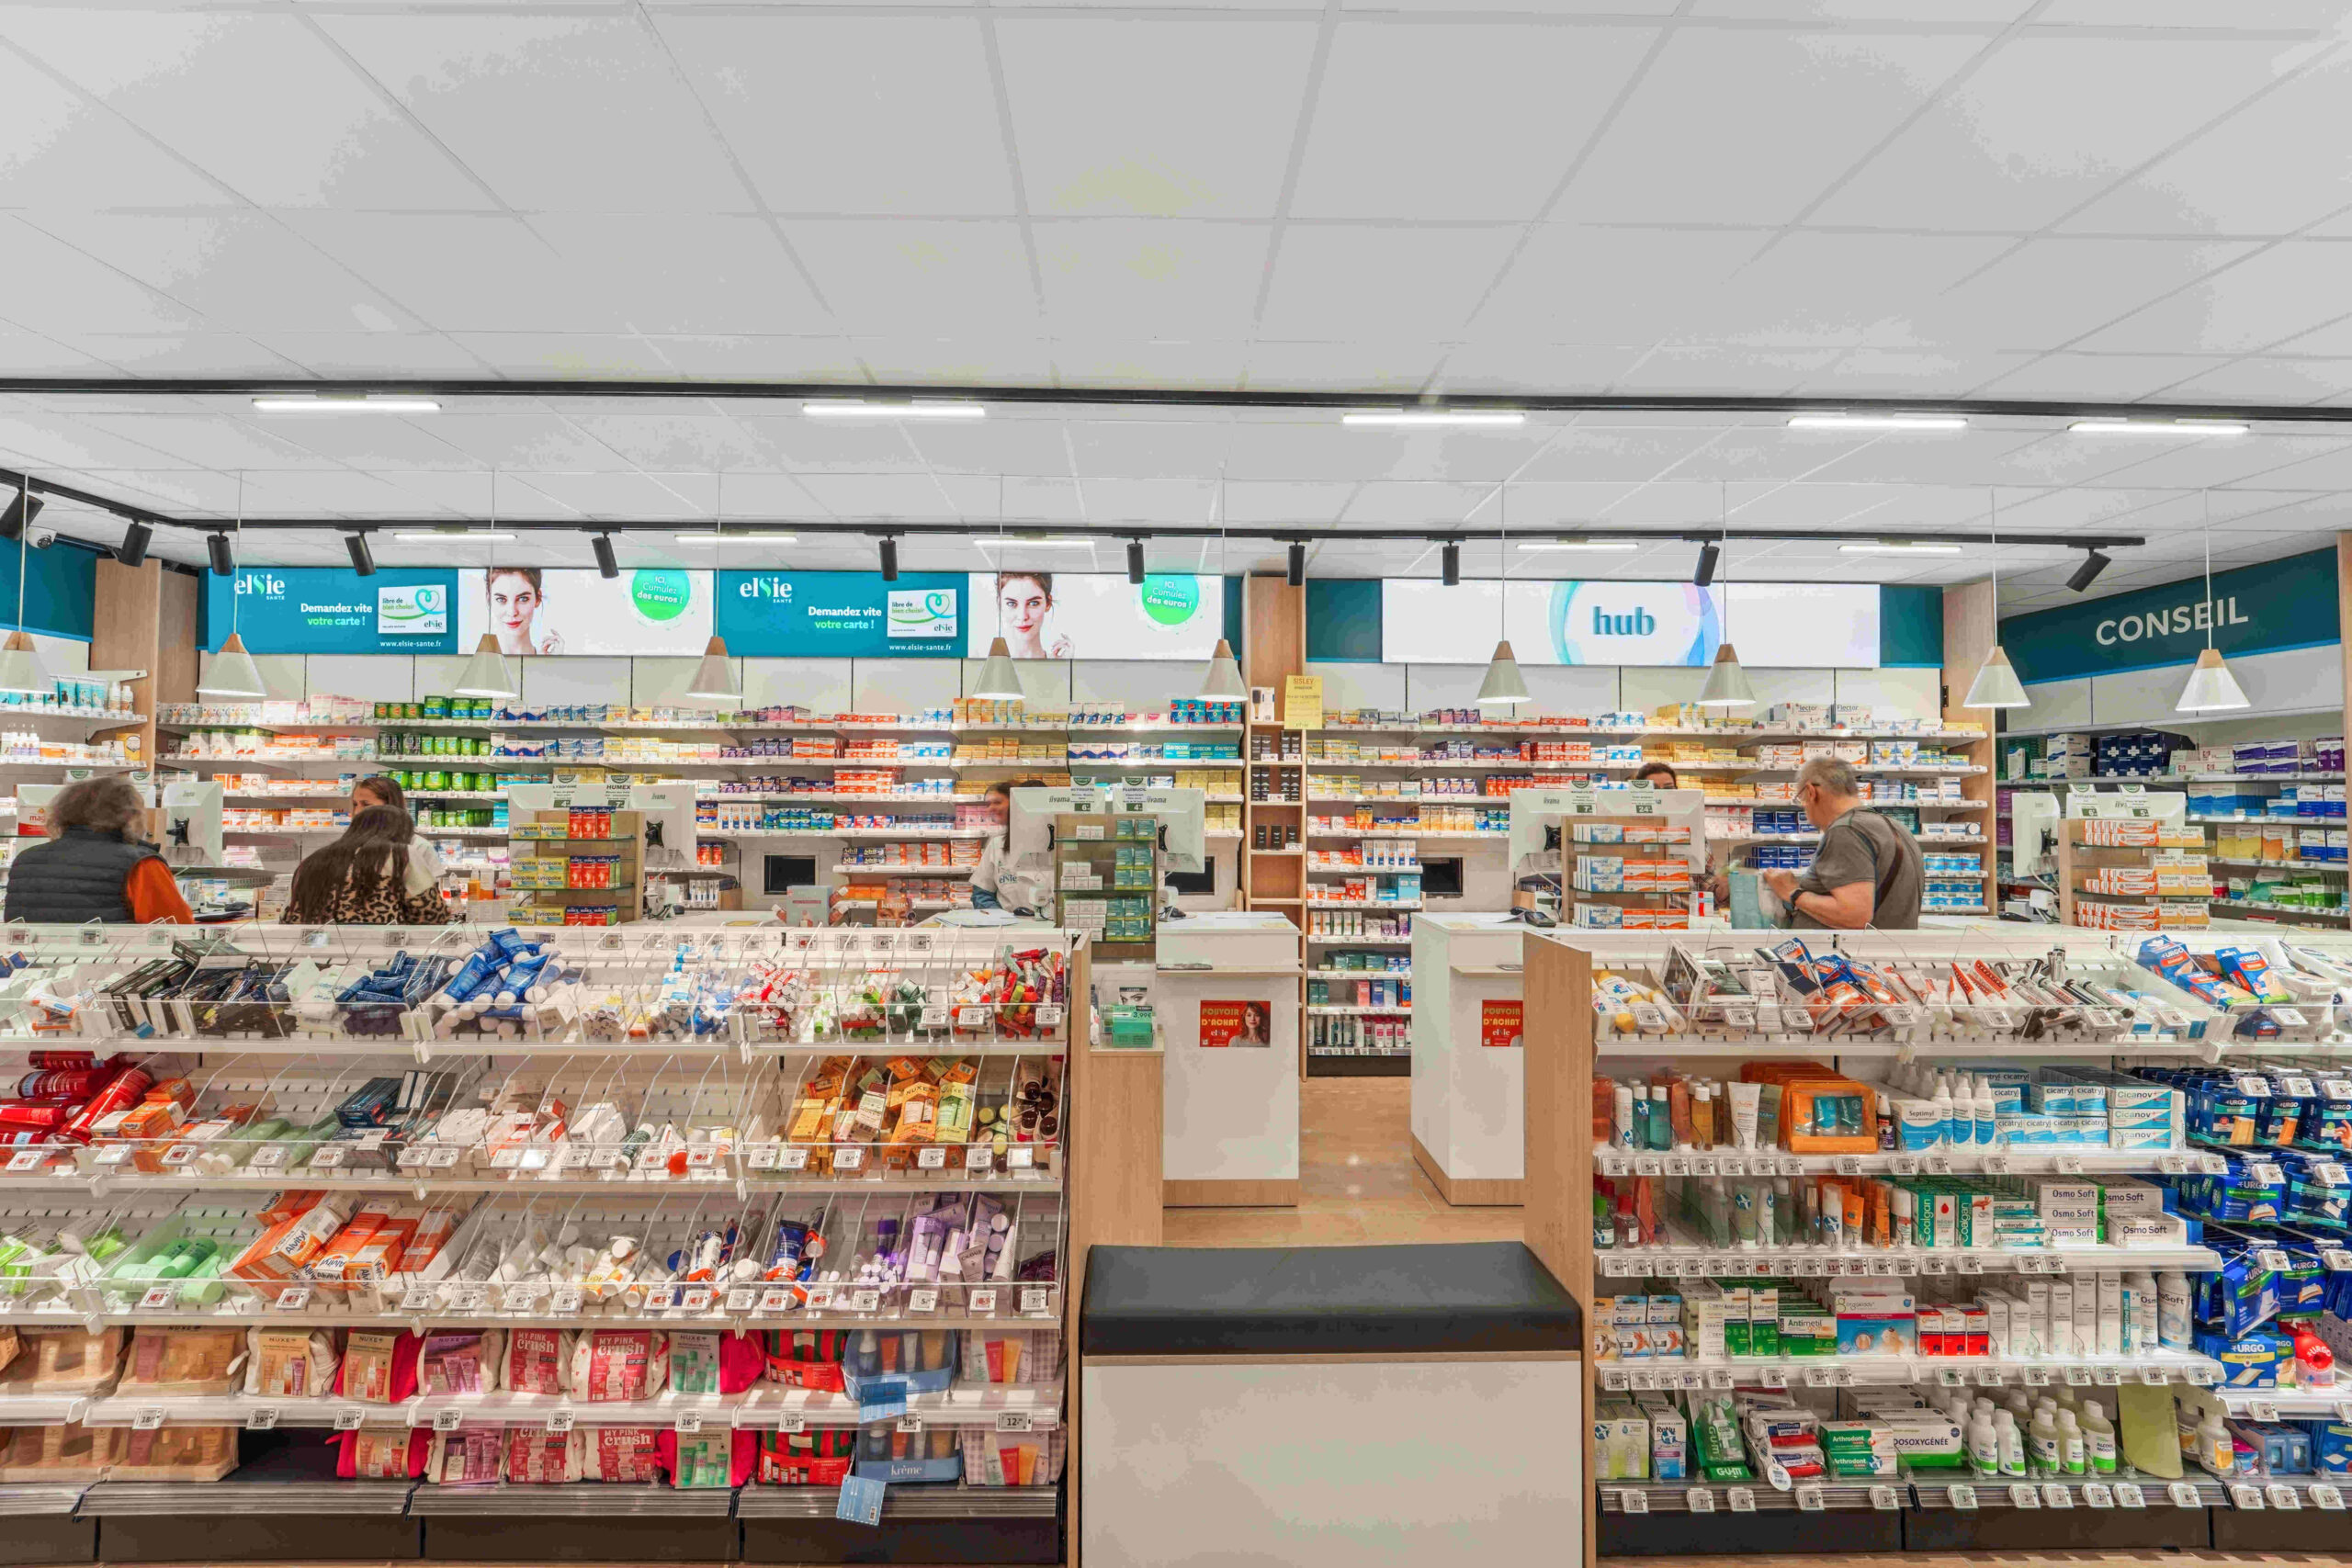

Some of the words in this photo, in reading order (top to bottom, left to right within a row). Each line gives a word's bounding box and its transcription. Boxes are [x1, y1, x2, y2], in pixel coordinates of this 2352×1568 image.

[642, 582, 677, 594] Cumulez
[740, 577, 792, 597] elsie
[637, 590, 652, 600] des
[653, 592, 677, 604] euros
[1152, 587, 1186, 600] Cumulez
[1147, 595, 1161, 605] des
[1162, 598, 1186, 608] euros
[300, 604, 352, 613] Demandez
[354, 604, 372, 613] vite
[808, 605, 860, 616] Demandez
[863, 606, 882, 615] vite
[308, 617, 333, 626] votre
[335, 616, 359, 626] carte
[815, 620, 841, 629] votre
[843, 620, 868, 629] carte
[1592, 605, 1657, 636] hub
[2095, 596, 2247, 646] CONSEIL
[2165, 946, 2184, 958] URGO
[2243, 954, 2260, 963] URGO
[1202, 1008, 1239, 1016] POUVOIR
[2003, 1073, 2029, 1081] cicatryl
[906, 1085, 928, 1096] NUXE
[1994, 1089, 2019, 1098] cicatryl
[2046, 1087, 2074, 1096] cicatryl
[2076, 1087, 2104, 1096] cicatryl
[1908, 1110, 1934, 1118] Septimyl
[1997, 1119, 2022, 1128] cicatryl
[2026, 1119, 2051, 1128] cicatryl
[2053, 1119, 2079, 1128] cicatryl
[2081, 1118, 2107, 1127] cicatryl
[2243, 1181, 2269, 1190] URGO
[2052, 1190, 2075, 1198] Osmo
[2077, 1189, 2095, 1198] Soft
[2104, 1193, 2124, 1201] Osmo
[2126, 1193, 2144, 1201] Soft
[2052, 1209, 2075, 1217] Osmo
[2077, 1208, 2094, 1217] Soft
[1920, 1199, 1934, 1242] Coalgan
[1961, 1202, 1970, 1242] Coalgan
[2052, 1228, 2075, 1237] Osmo
[2076, 1227, 2094, 1236] Soft
[2122, 1225, 2147, 1234] Osmo
[2148, 1225, 2167, 1234] Soft
[285, 1230, 308, 1255] Alvityl
[2297, 1261, 2318, 1269] URGO
[530, 1332, 547, 1341] PINK
[517, 1338, 555, 1353] crush
[597, 1342, 645, 1355] crush
[2237, 1344, 2265, 1353] URGO
[2310, 1346, 2332, 1357] URGO
[605, 1434, 650, 1446] crush
[1833, 1435, 1864, 1443] Arthrodont
[1894, 1437, 1949, 1446] DOSOXYGÉNÉE
[1834, 1457, 1867, 1465] Arthrodont
[891, 1465, 922, 1476] krème
